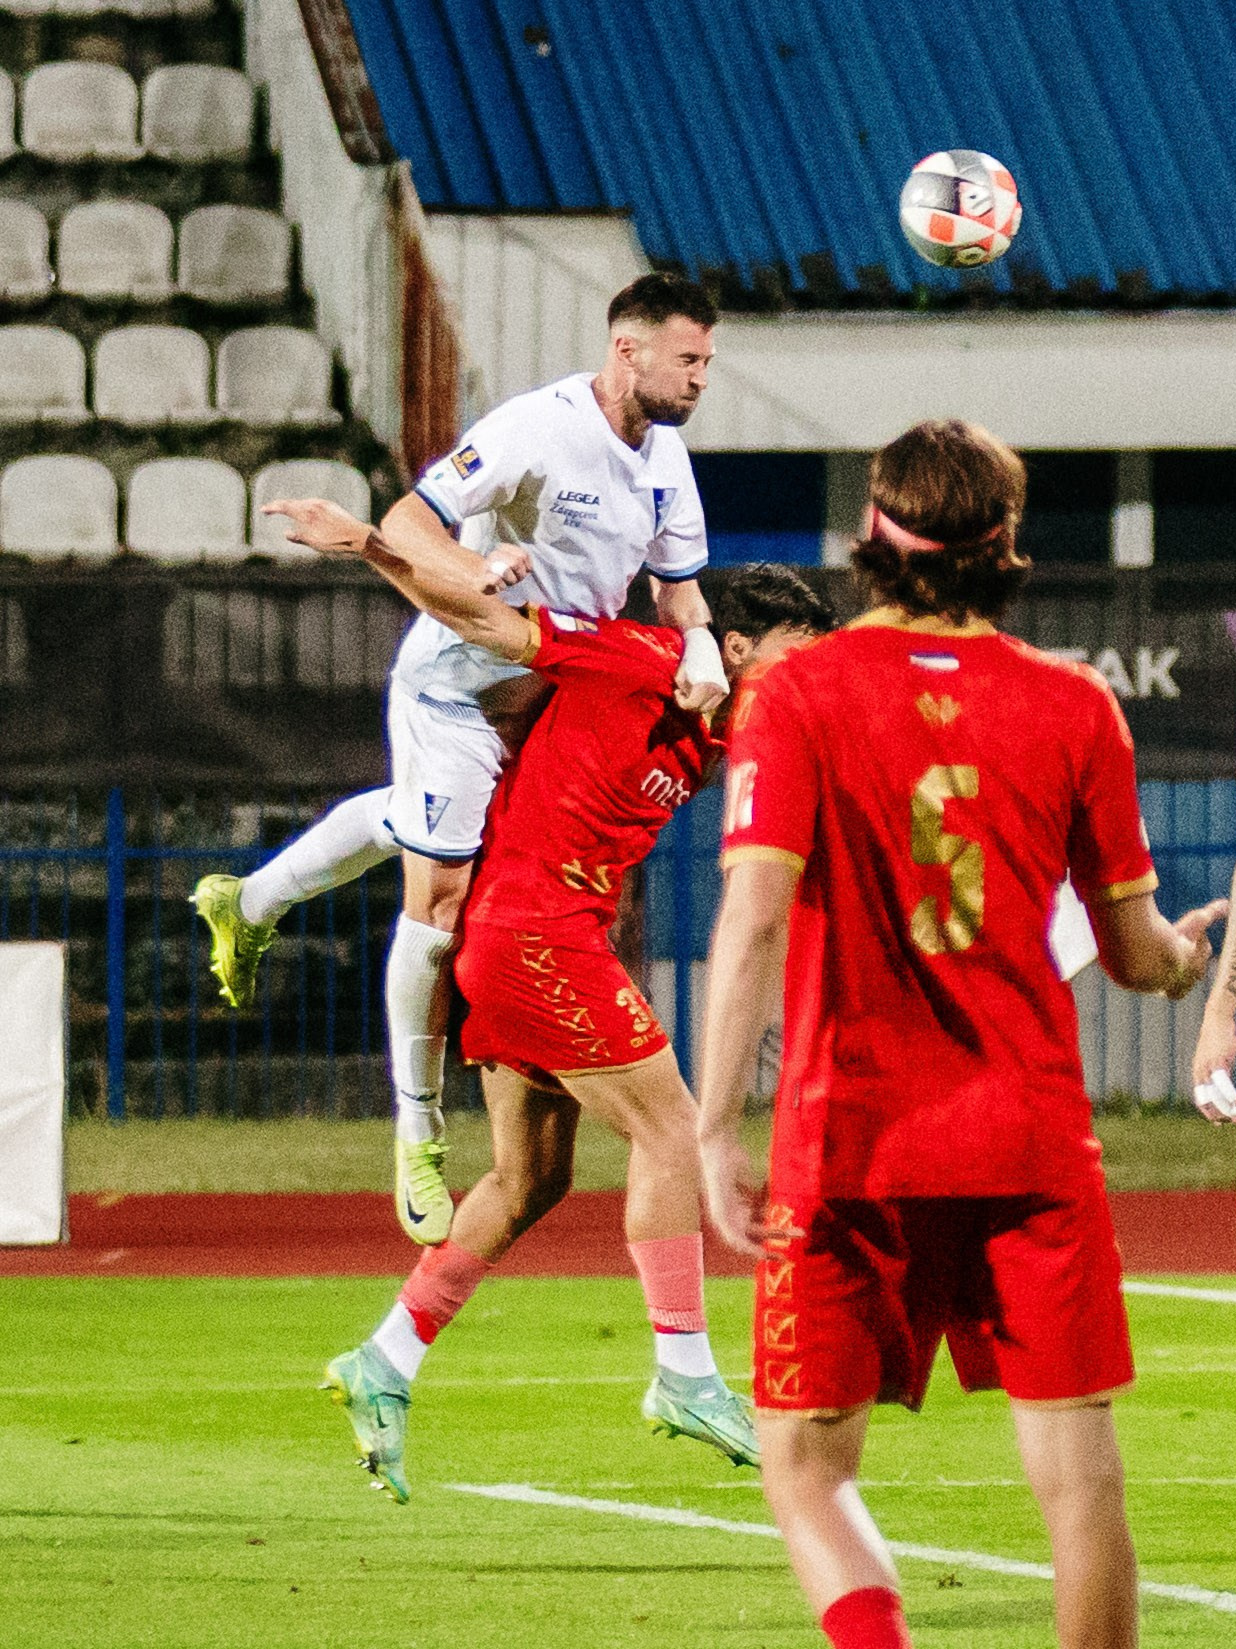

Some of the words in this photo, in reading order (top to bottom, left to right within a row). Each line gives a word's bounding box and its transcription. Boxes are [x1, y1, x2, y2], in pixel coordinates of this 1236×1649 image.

[557, 490, 600, 505] LEGEA
[1046, 647, 1181, 698] АК
[910, 764, 984, 956] 5
